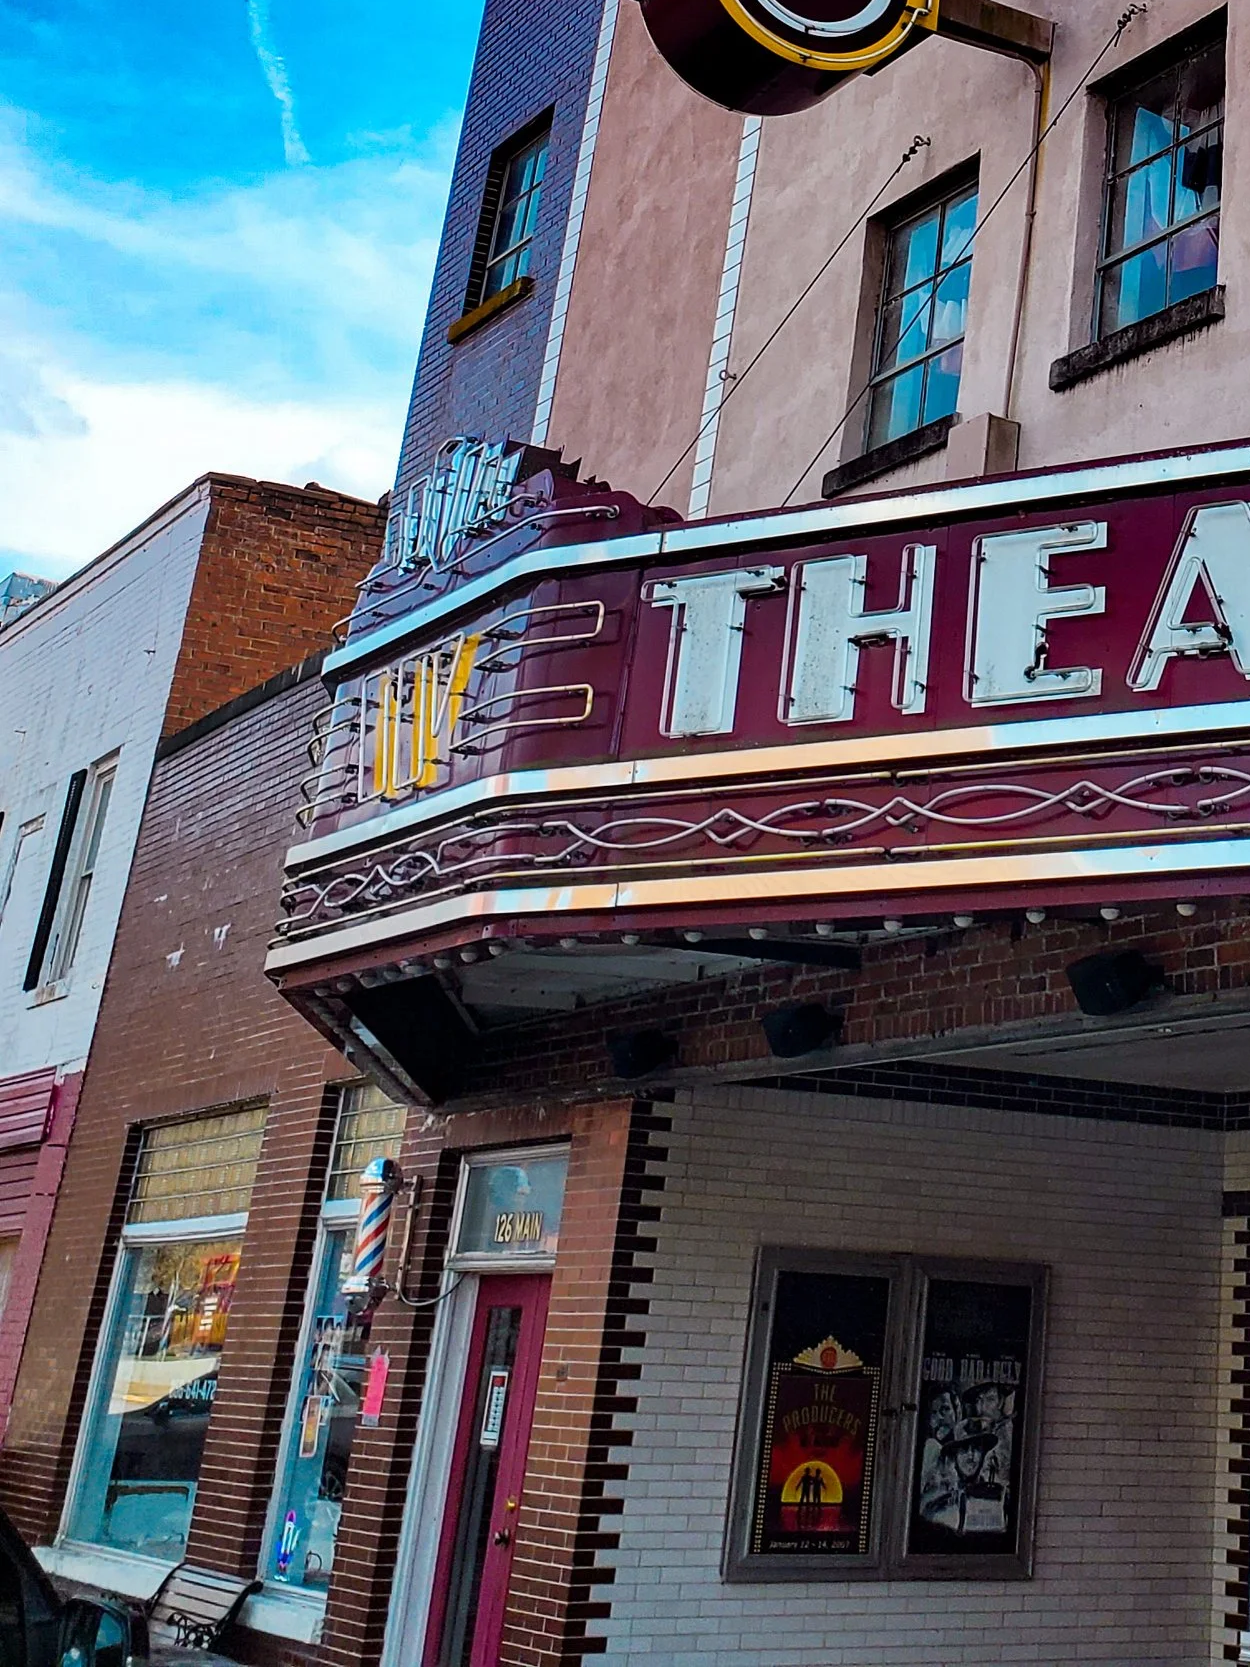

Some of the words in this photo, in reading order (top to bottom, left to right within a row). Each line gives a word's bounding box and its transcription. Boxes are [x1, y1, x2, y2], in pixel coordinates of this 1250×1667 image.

[494, 1213, 514, 1243] 126
[513, 1211, 543, 1242] MAIN
[814, 1383, 836, 1403] THE
[782, 1405, 861, 1436] PRODUCERS
